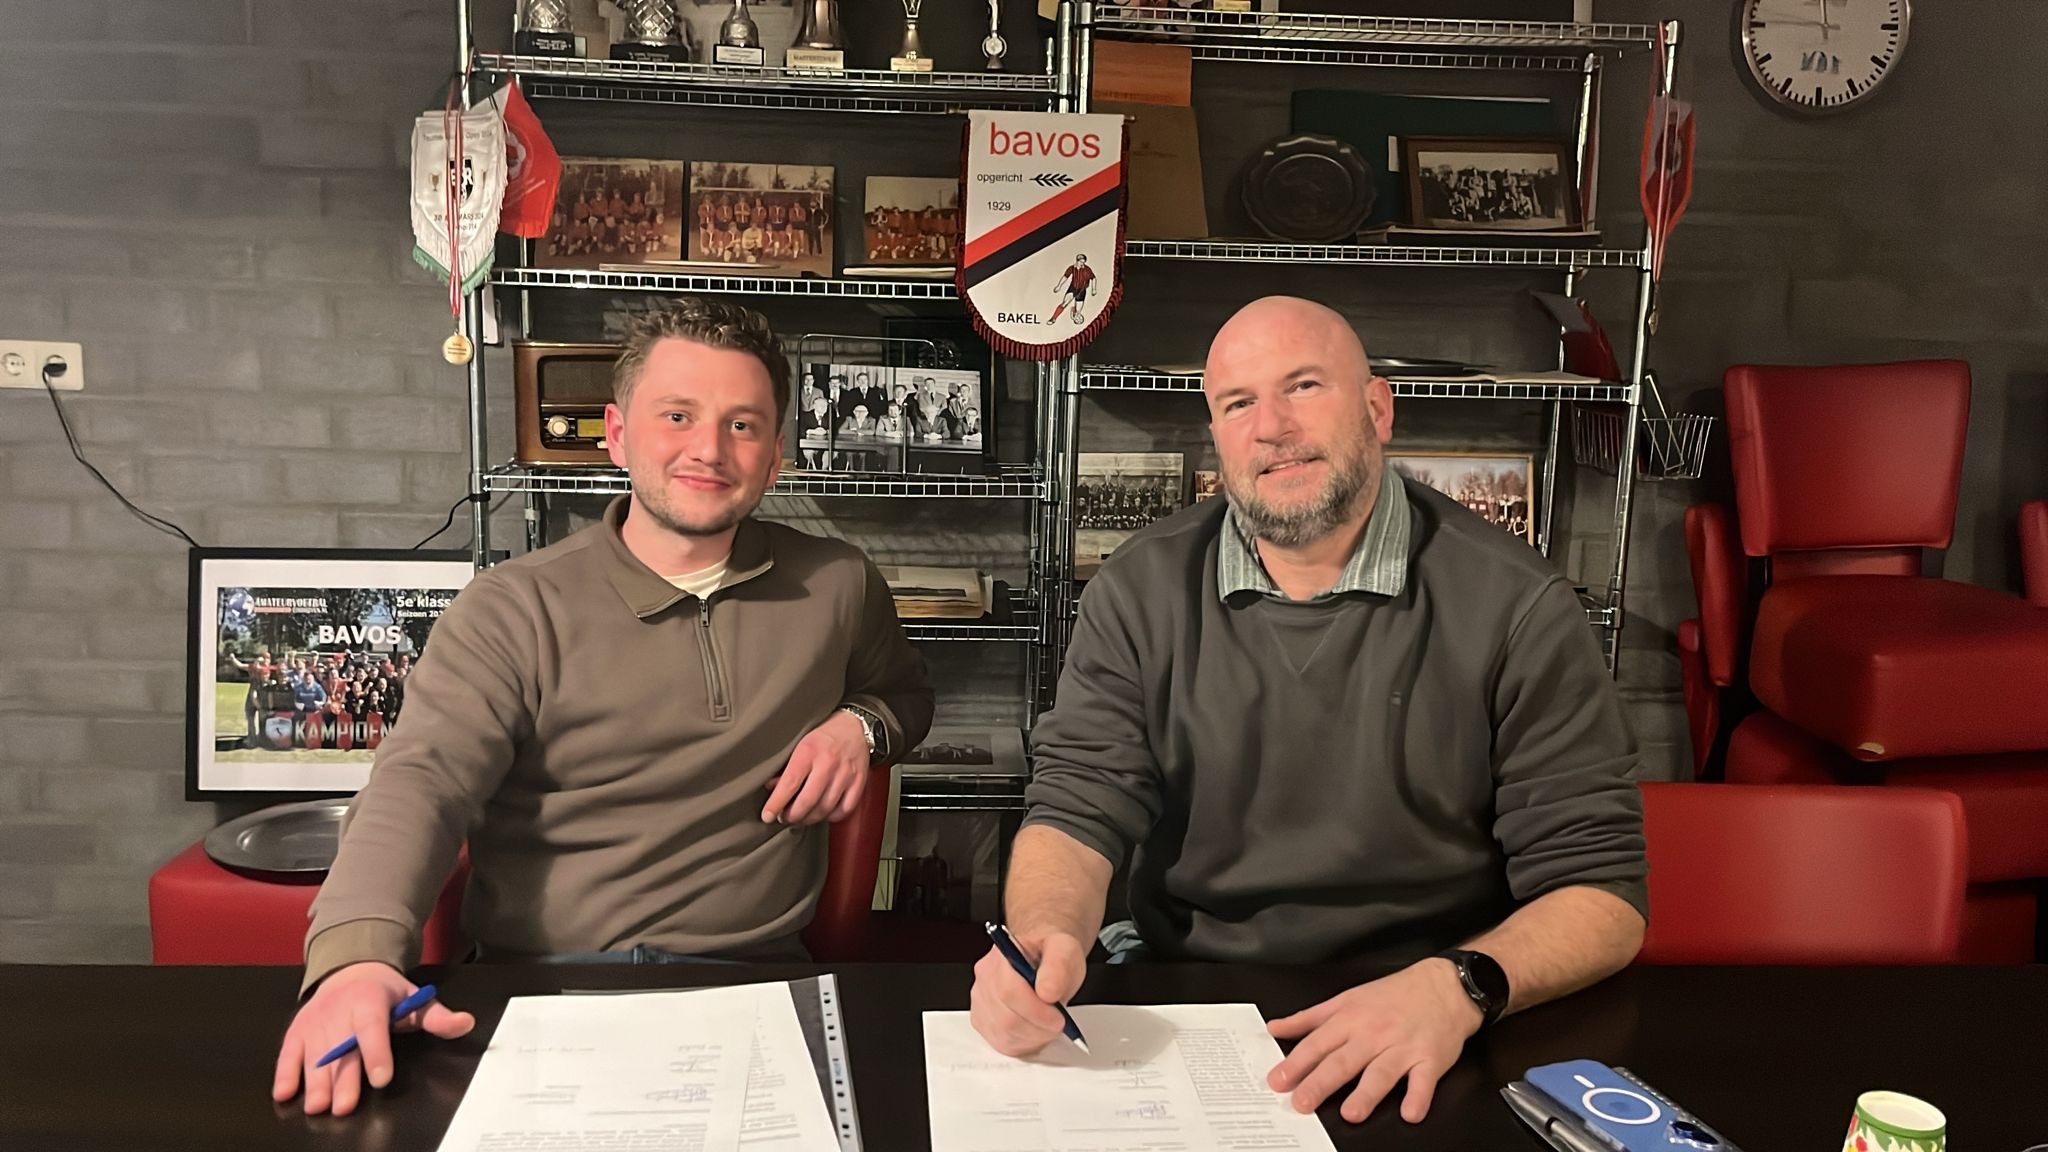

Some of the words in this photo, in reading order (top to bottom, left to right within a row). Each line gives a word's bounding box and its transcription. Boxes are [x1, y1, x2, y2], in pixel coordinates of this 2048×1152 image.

[990, 122, 1101, 158] bavos
[977, 173, 1023, 184] opgericht
[987, 201, 1011, 211] 1929
[997, 312, 1041, 325] BAKEL
[396, 595, 414, 608] 5e
[417, 595, 453, 608] klass
[397, 610, 427, 618] Seizoen
[319, 625, 402, 645] BAVOS
